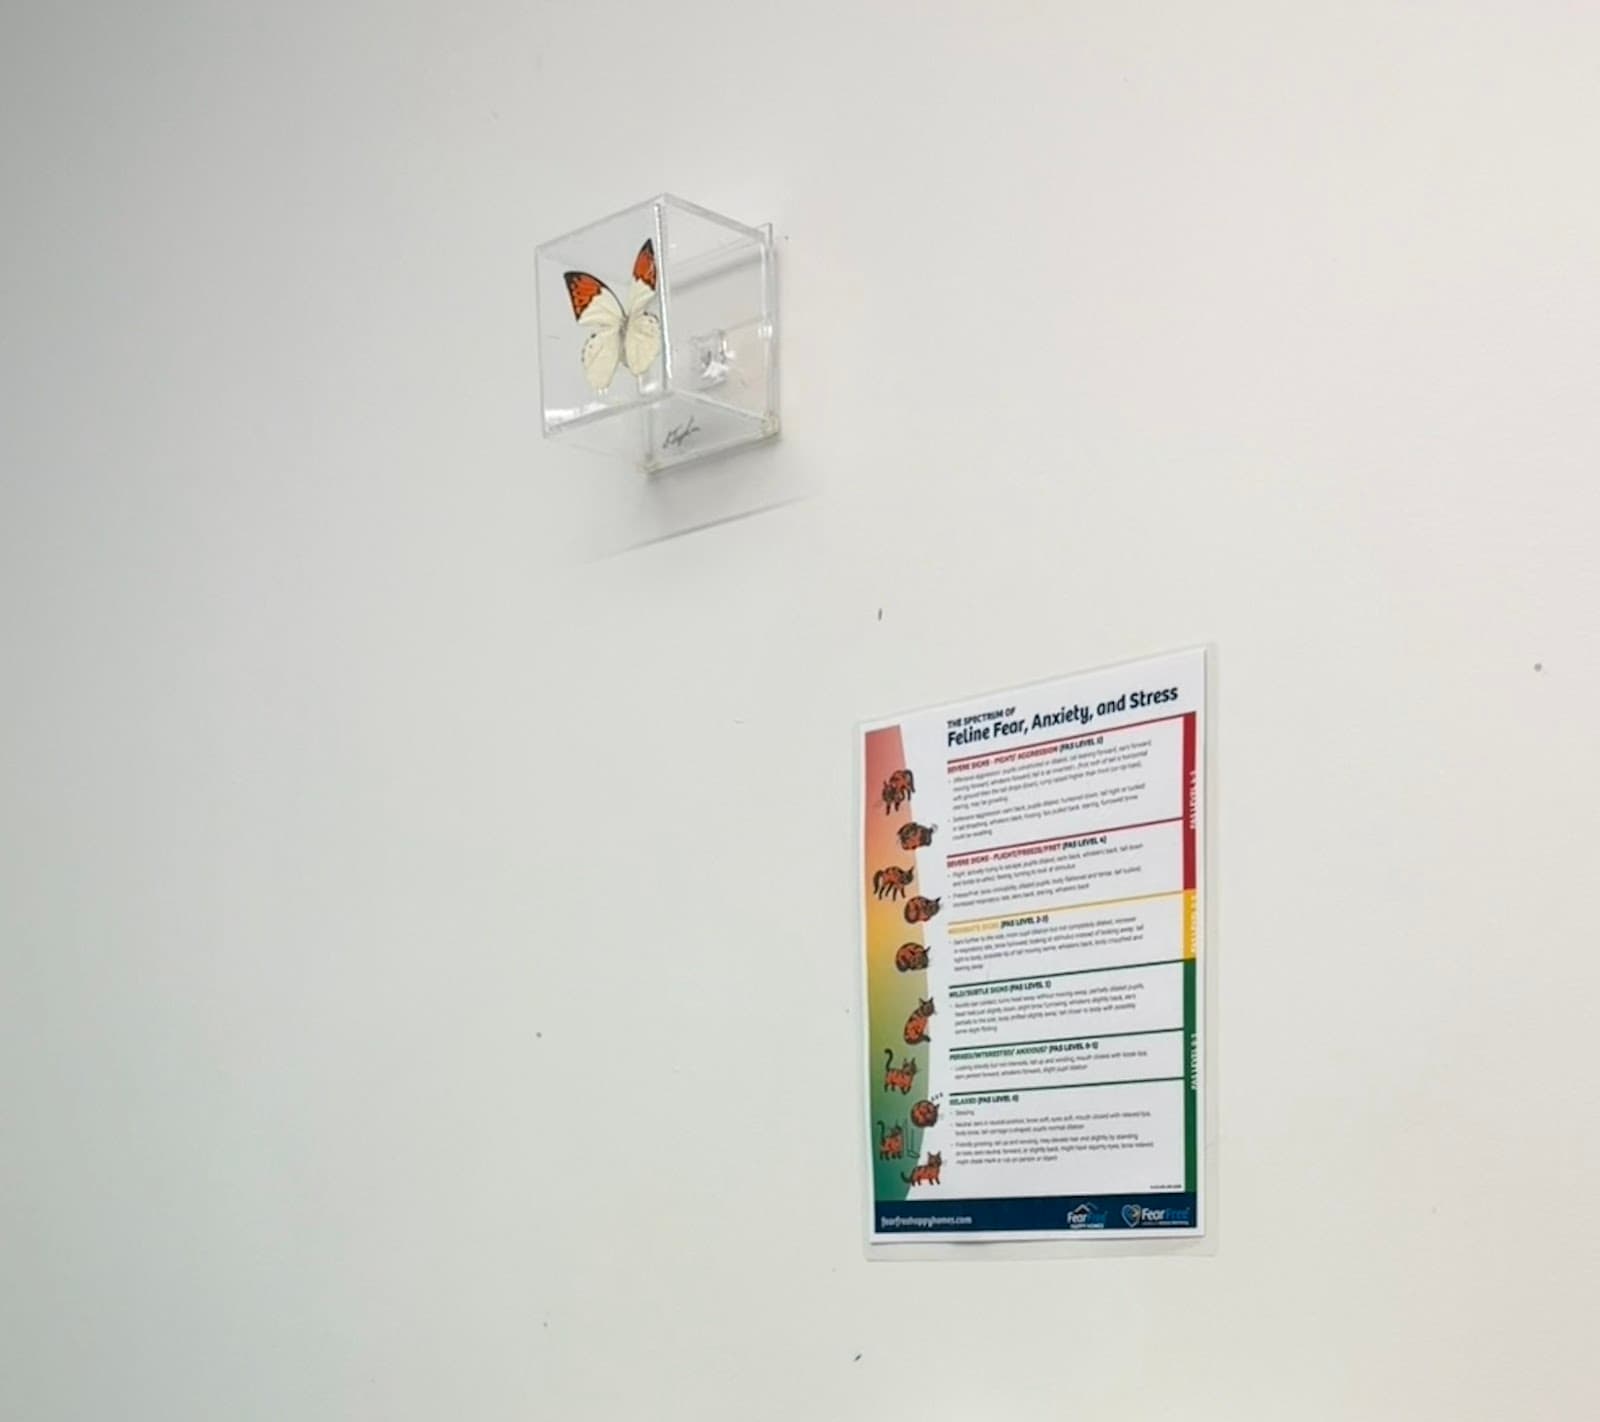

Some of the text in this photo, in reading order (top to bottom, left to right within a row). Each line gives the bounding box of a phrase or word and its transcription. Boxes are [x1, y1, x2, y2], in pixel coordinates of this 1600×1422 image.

[947, 706, 1016, 728] THE SPECTRUM OF
[948, 687, 1178, 747] Feline Fear, Anxiety, and Stress
